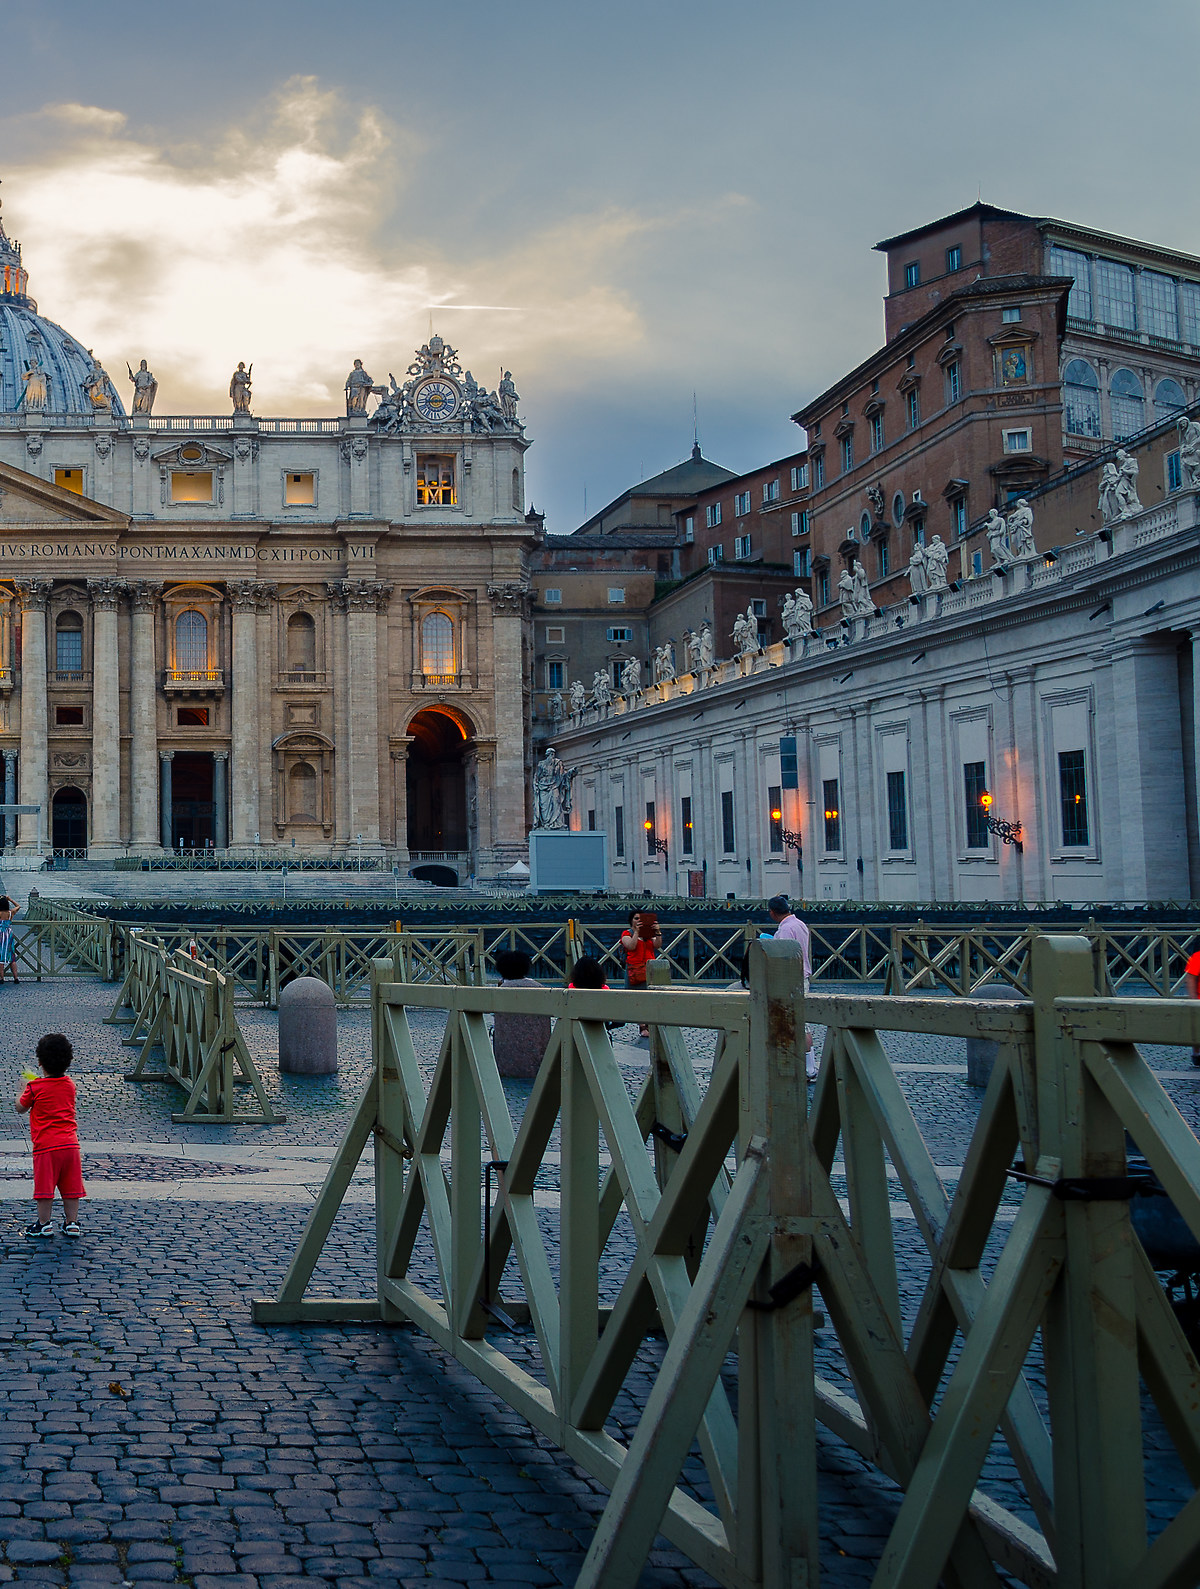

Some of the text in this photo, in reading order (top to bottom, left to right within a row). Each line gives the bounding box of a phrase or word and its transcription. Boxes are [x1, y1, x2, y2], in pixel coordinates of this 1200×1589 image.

[30, 544, 116, 556] ROMANVS
[119, 546, 164, 558] PONT
[165, 546, 201, 558] MAX
[203, 546, 225, 558] AN
[299, 549, 344, 561] PONT
[350, 546, 374, 558] VII
